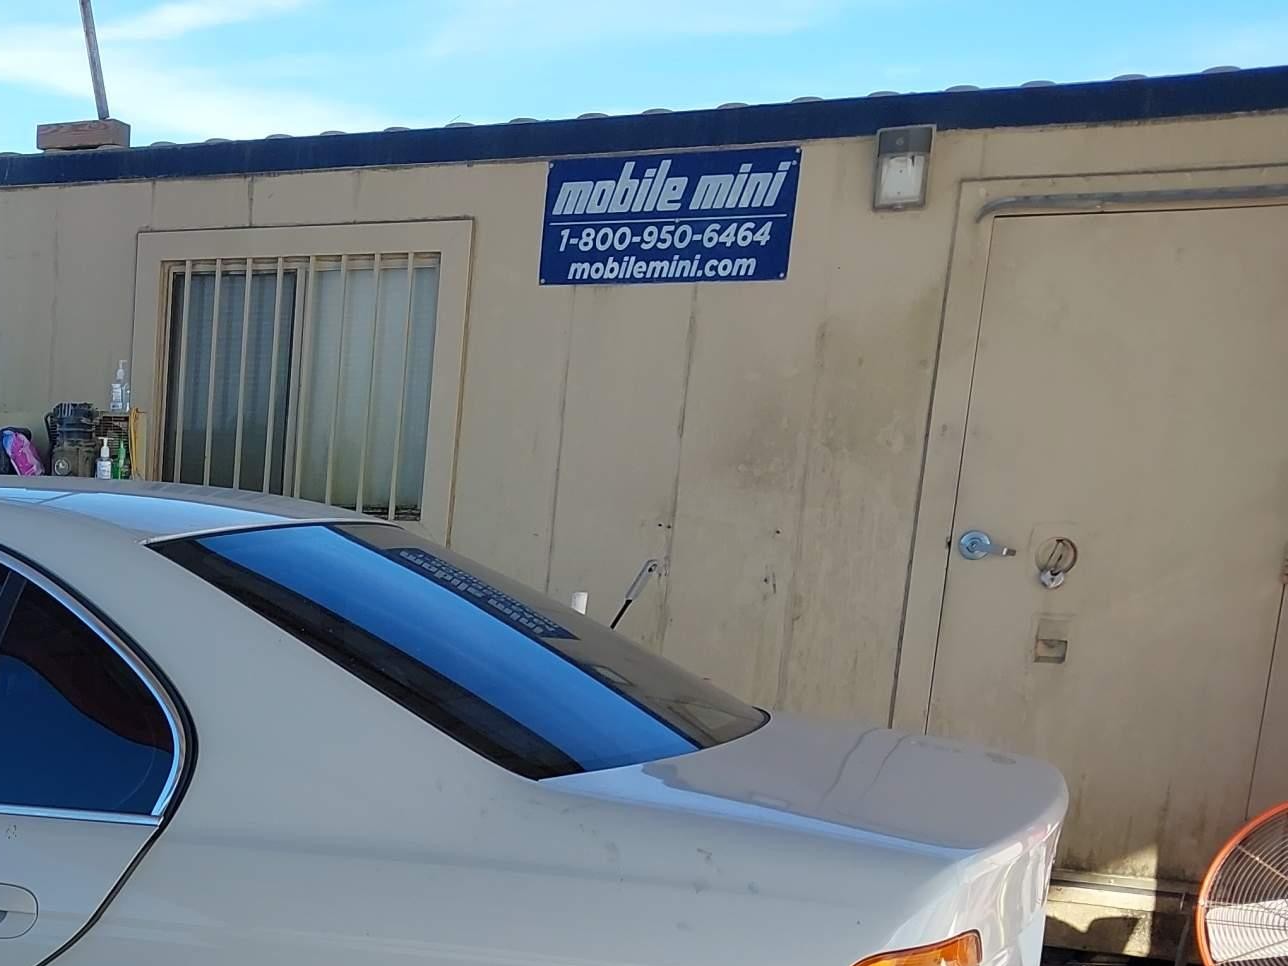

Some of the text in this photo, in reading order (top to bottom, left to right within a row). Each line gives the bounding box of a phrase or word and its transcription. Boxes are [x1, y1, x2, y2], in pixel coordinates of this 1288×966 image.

[552, 159, 791, 215] mobile mini
[559, 221, 773, 251] 1-800-950-6464
[568, 254, 756, 279] mobilemini.com
